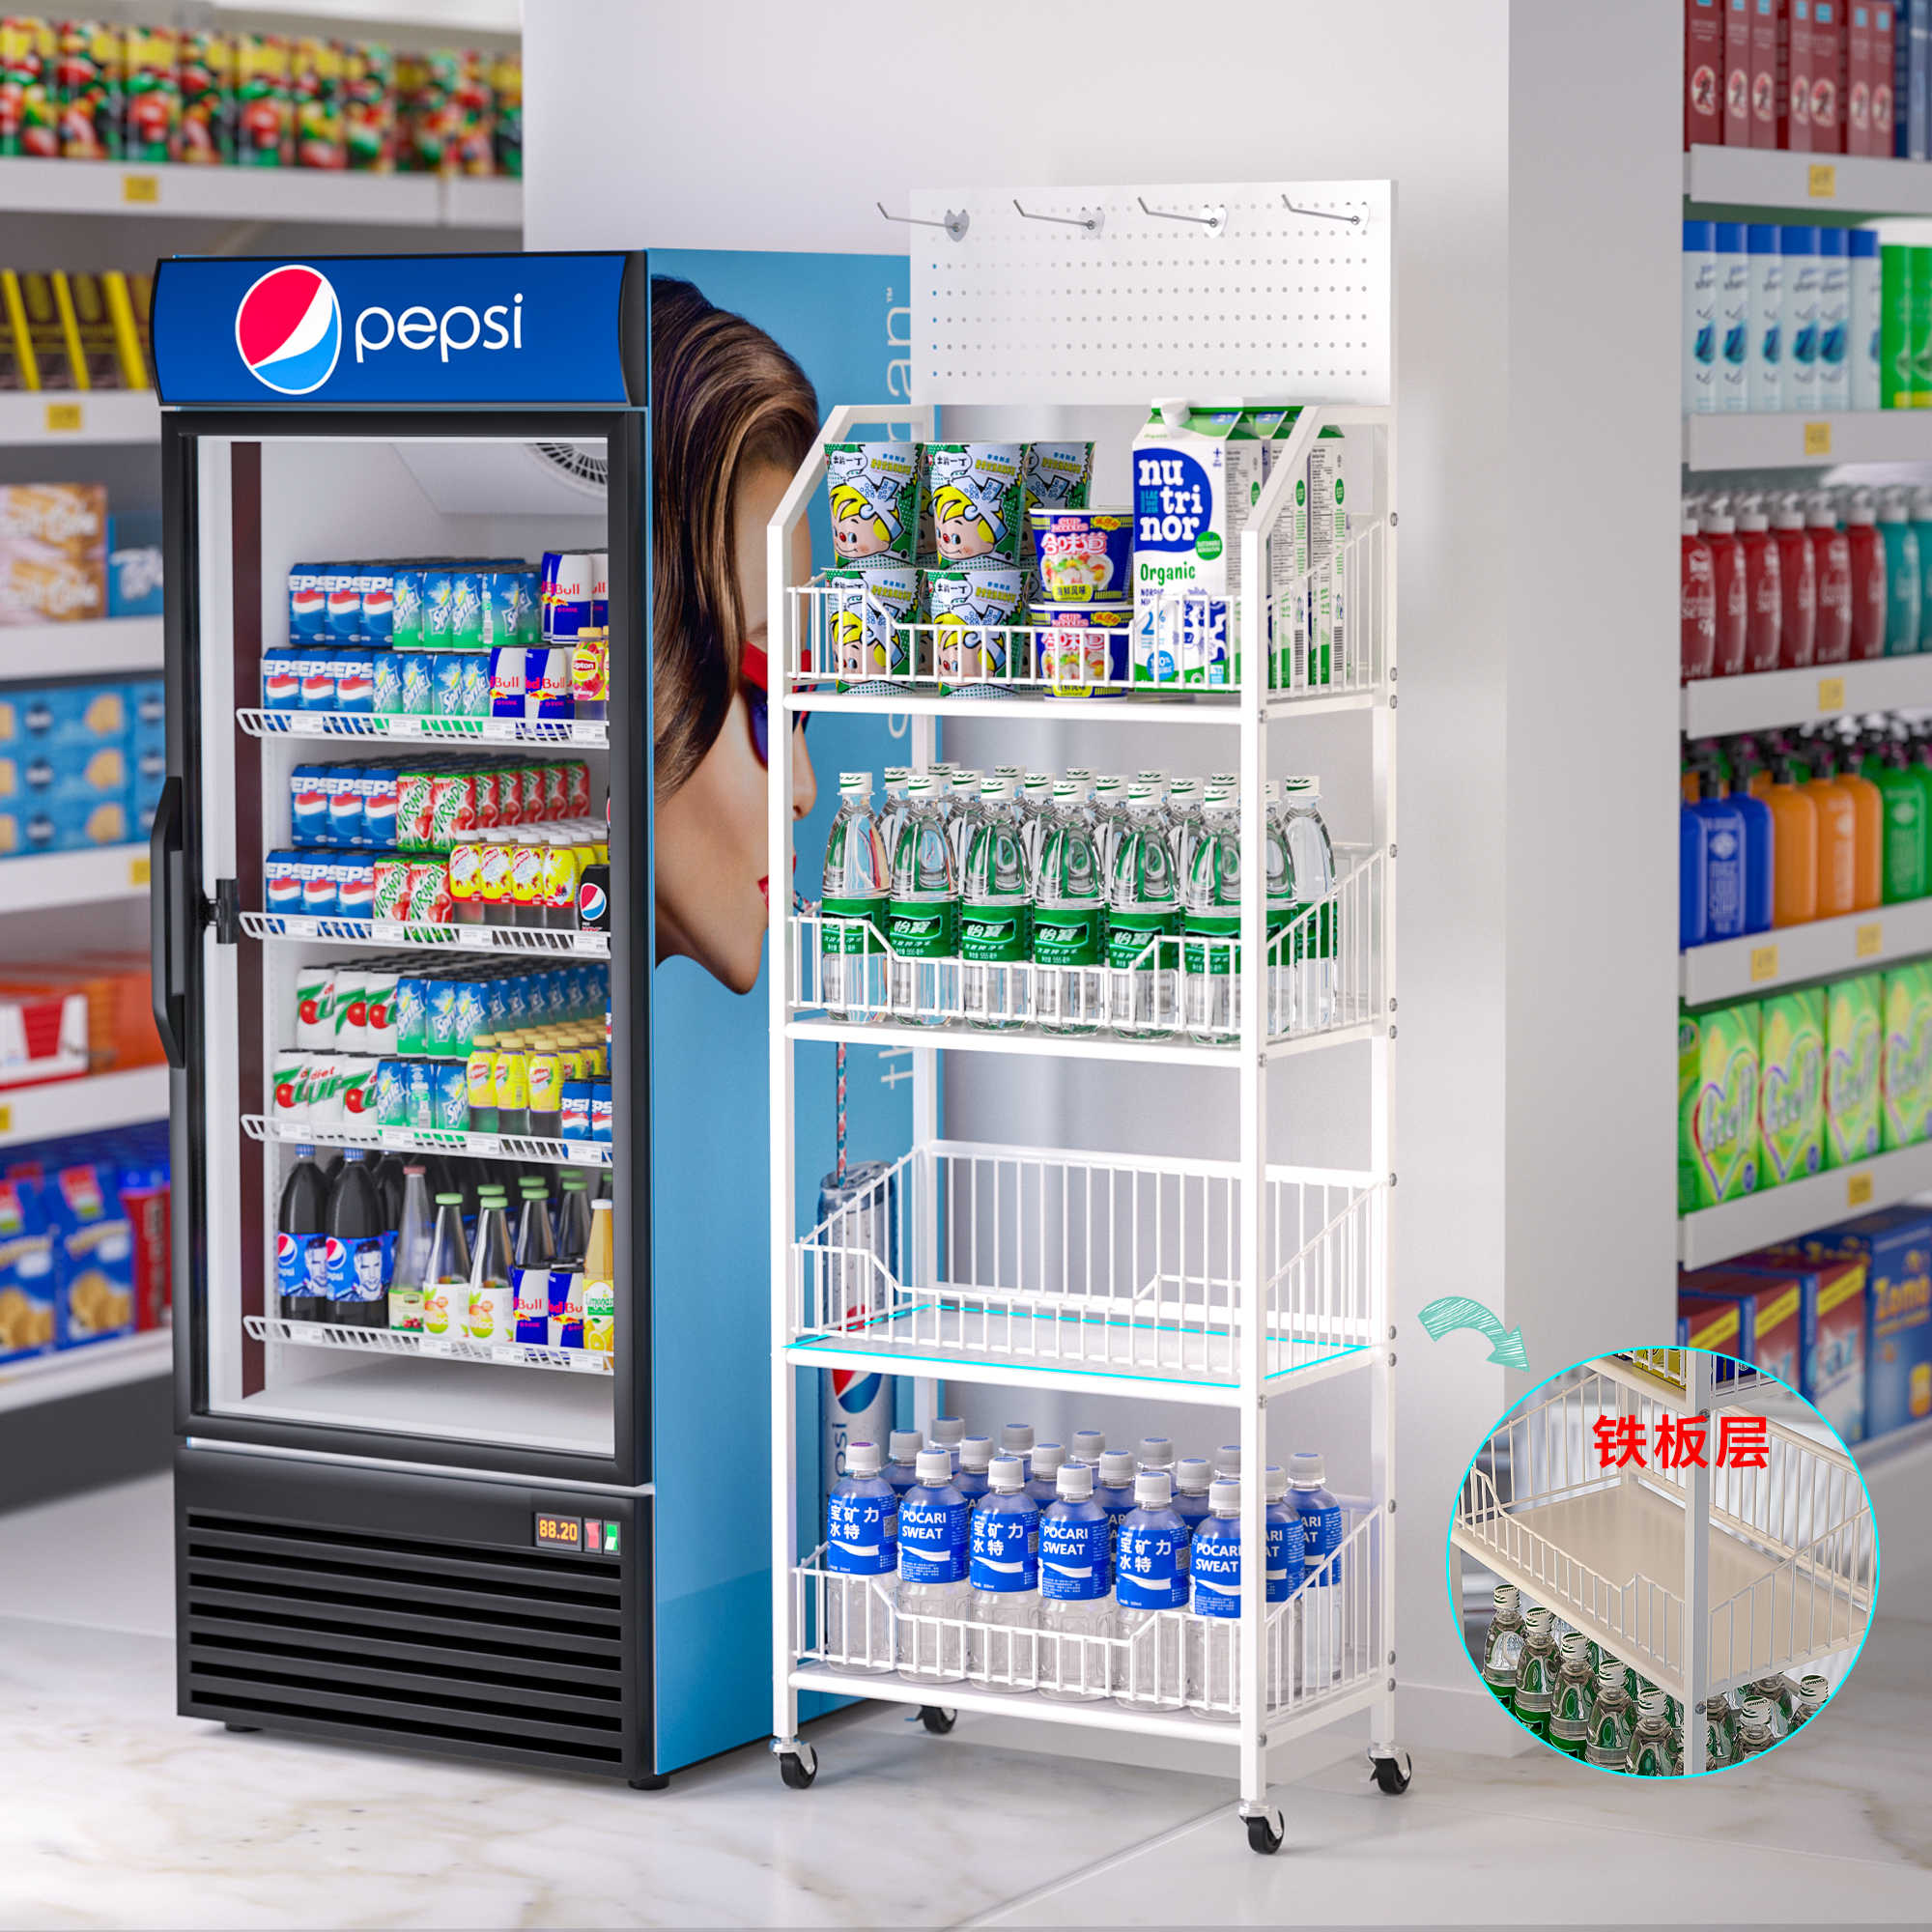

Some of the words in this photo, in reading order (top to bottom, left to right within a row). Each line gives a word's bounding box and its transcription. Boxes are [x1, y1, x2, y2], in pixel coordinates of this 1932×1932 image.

[355, 293, 524, 363] pepsi
[1140, 515, 1200, 542] nor
[1141, 561, 1196, 586] Organic
[564, 1302, 582, 1314] Bu
[902, 1510, 947, 1524] POCARI
[539, 1519, 578, 1542] 88.20
[902, 1525, 944, 1540] SWEAT
[1043, 1525, 1089, 1540] POCARI
[1043, 1541, 1085, 1555] SWEAT
[1196, 1557, 1238, 1573] SWEAT
